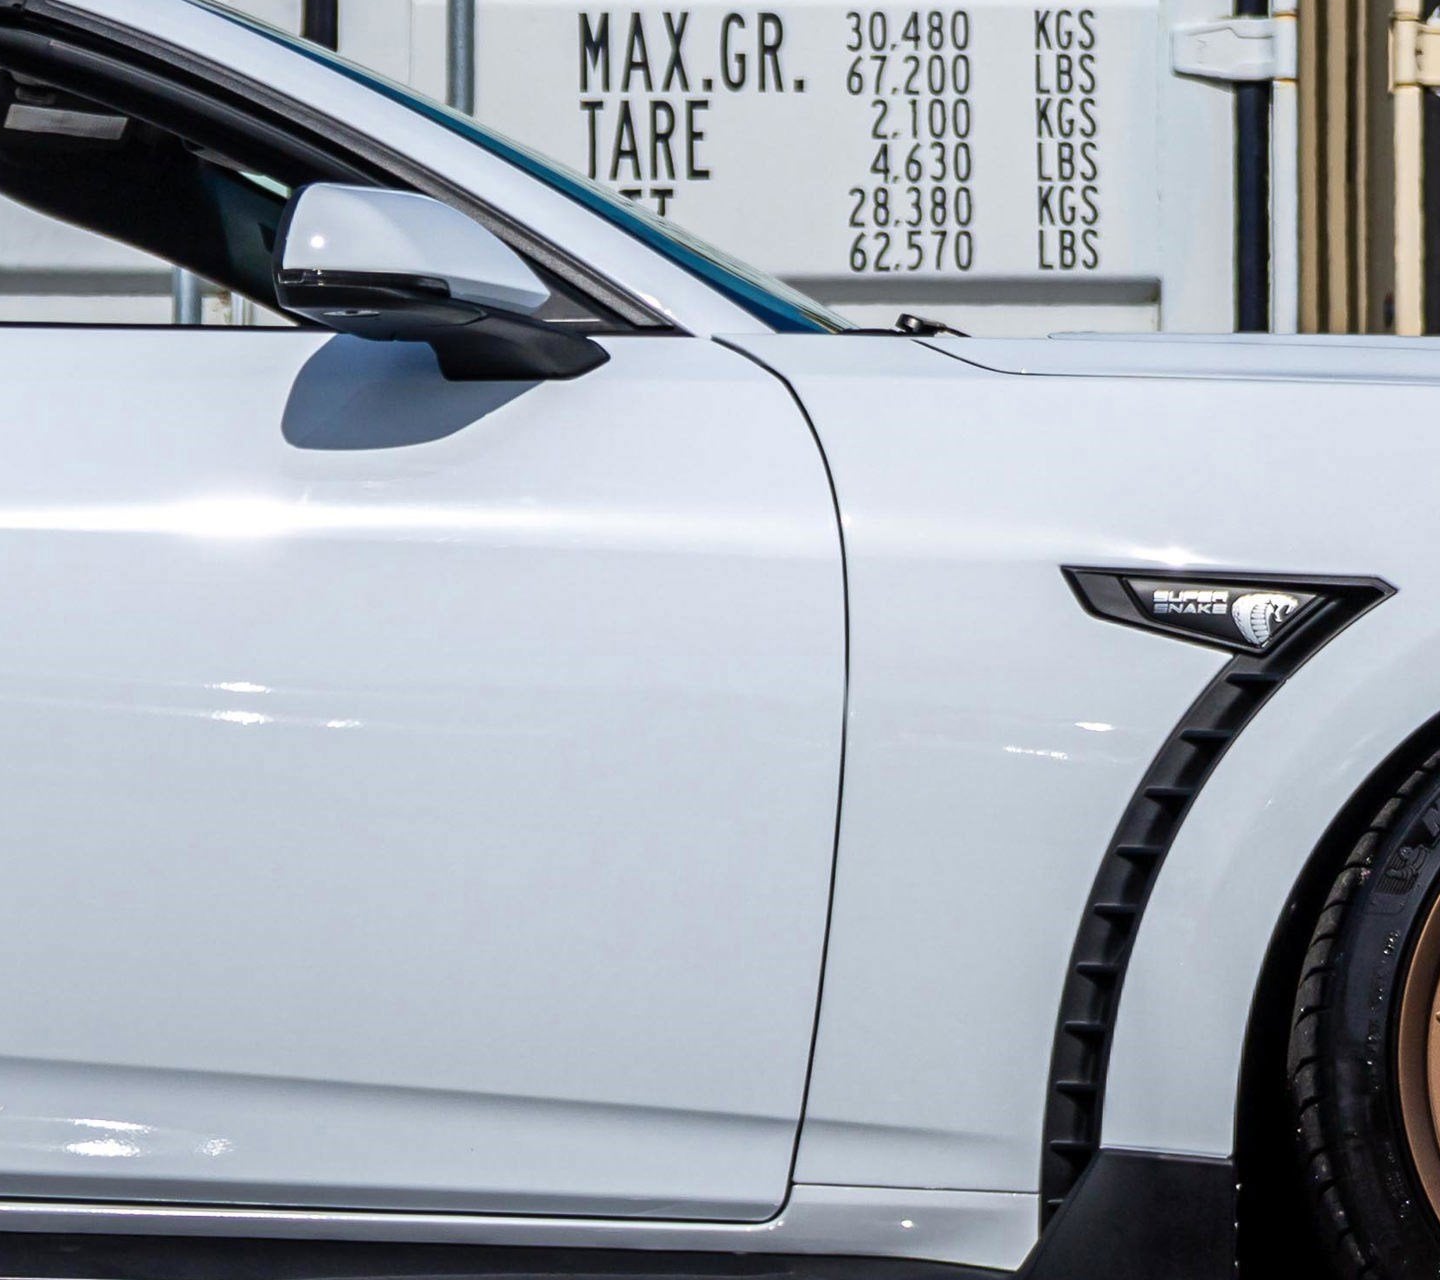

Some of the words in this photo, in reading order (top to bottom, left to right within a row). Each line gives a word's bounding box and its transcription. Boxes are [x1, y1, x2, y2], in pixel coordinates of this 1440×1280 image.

[1034, 9, 1095, 51] KGS
[578, 11, 805, 93] MAX.GR.
[1035, 53, 1096, 95] LBS
[1035, 97, 1097, 139] KGS
[579, 99, 711, 181] TARE
[1036, 141, 1098, 182] LBS
[1037, 185, 1099, 227] KGS
[1038, 229, 1099, 271] LBS
[1153, 589, 1229, 603] SUPER
[1153, 602, 1227, 615] SNAKE
